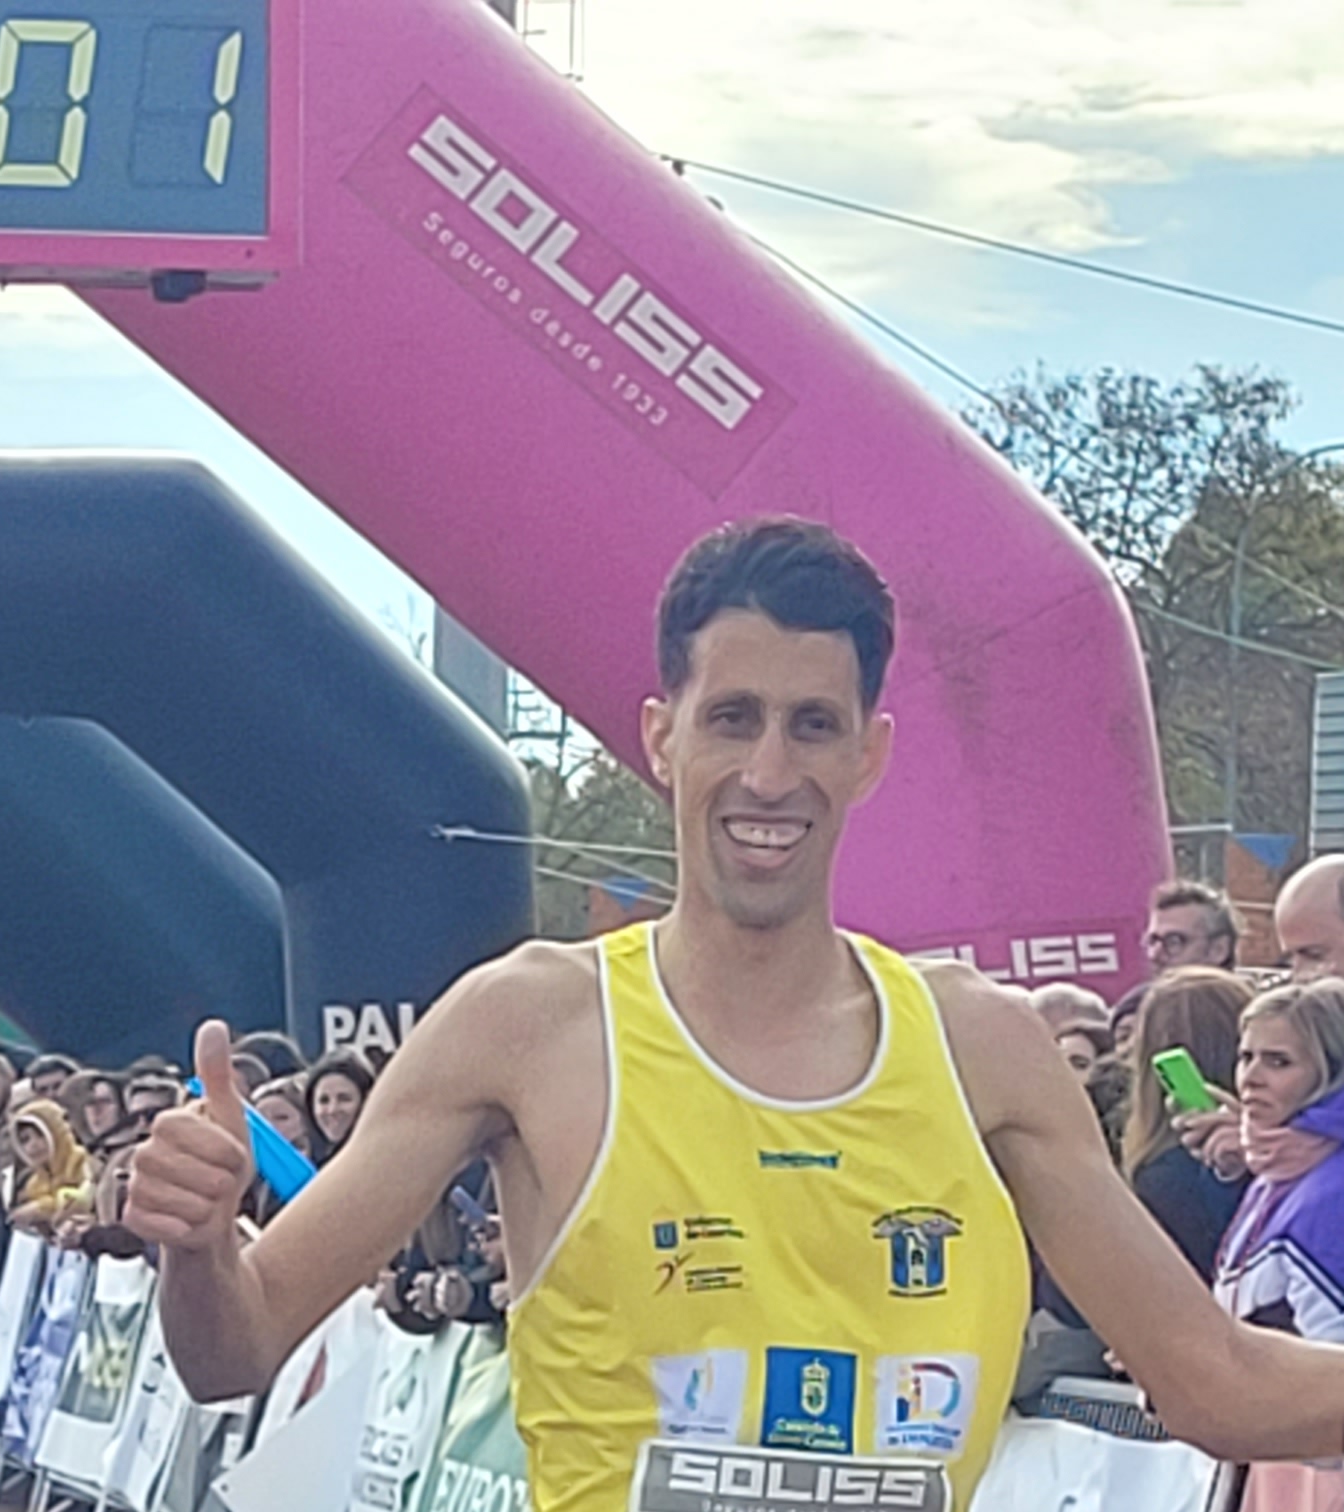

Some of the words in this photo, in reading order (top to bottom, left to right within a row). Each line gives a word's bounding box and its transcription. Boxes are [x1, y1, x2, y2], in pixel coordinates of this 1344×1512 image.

[407, 114, 764, 431] SOLISS
[422, 210, 523, 305] Seguros
[529, 307, 604, 372] desde
[611, 373, 669, 427] 1933
[668, 1451, 927, 1506] SOLISS
